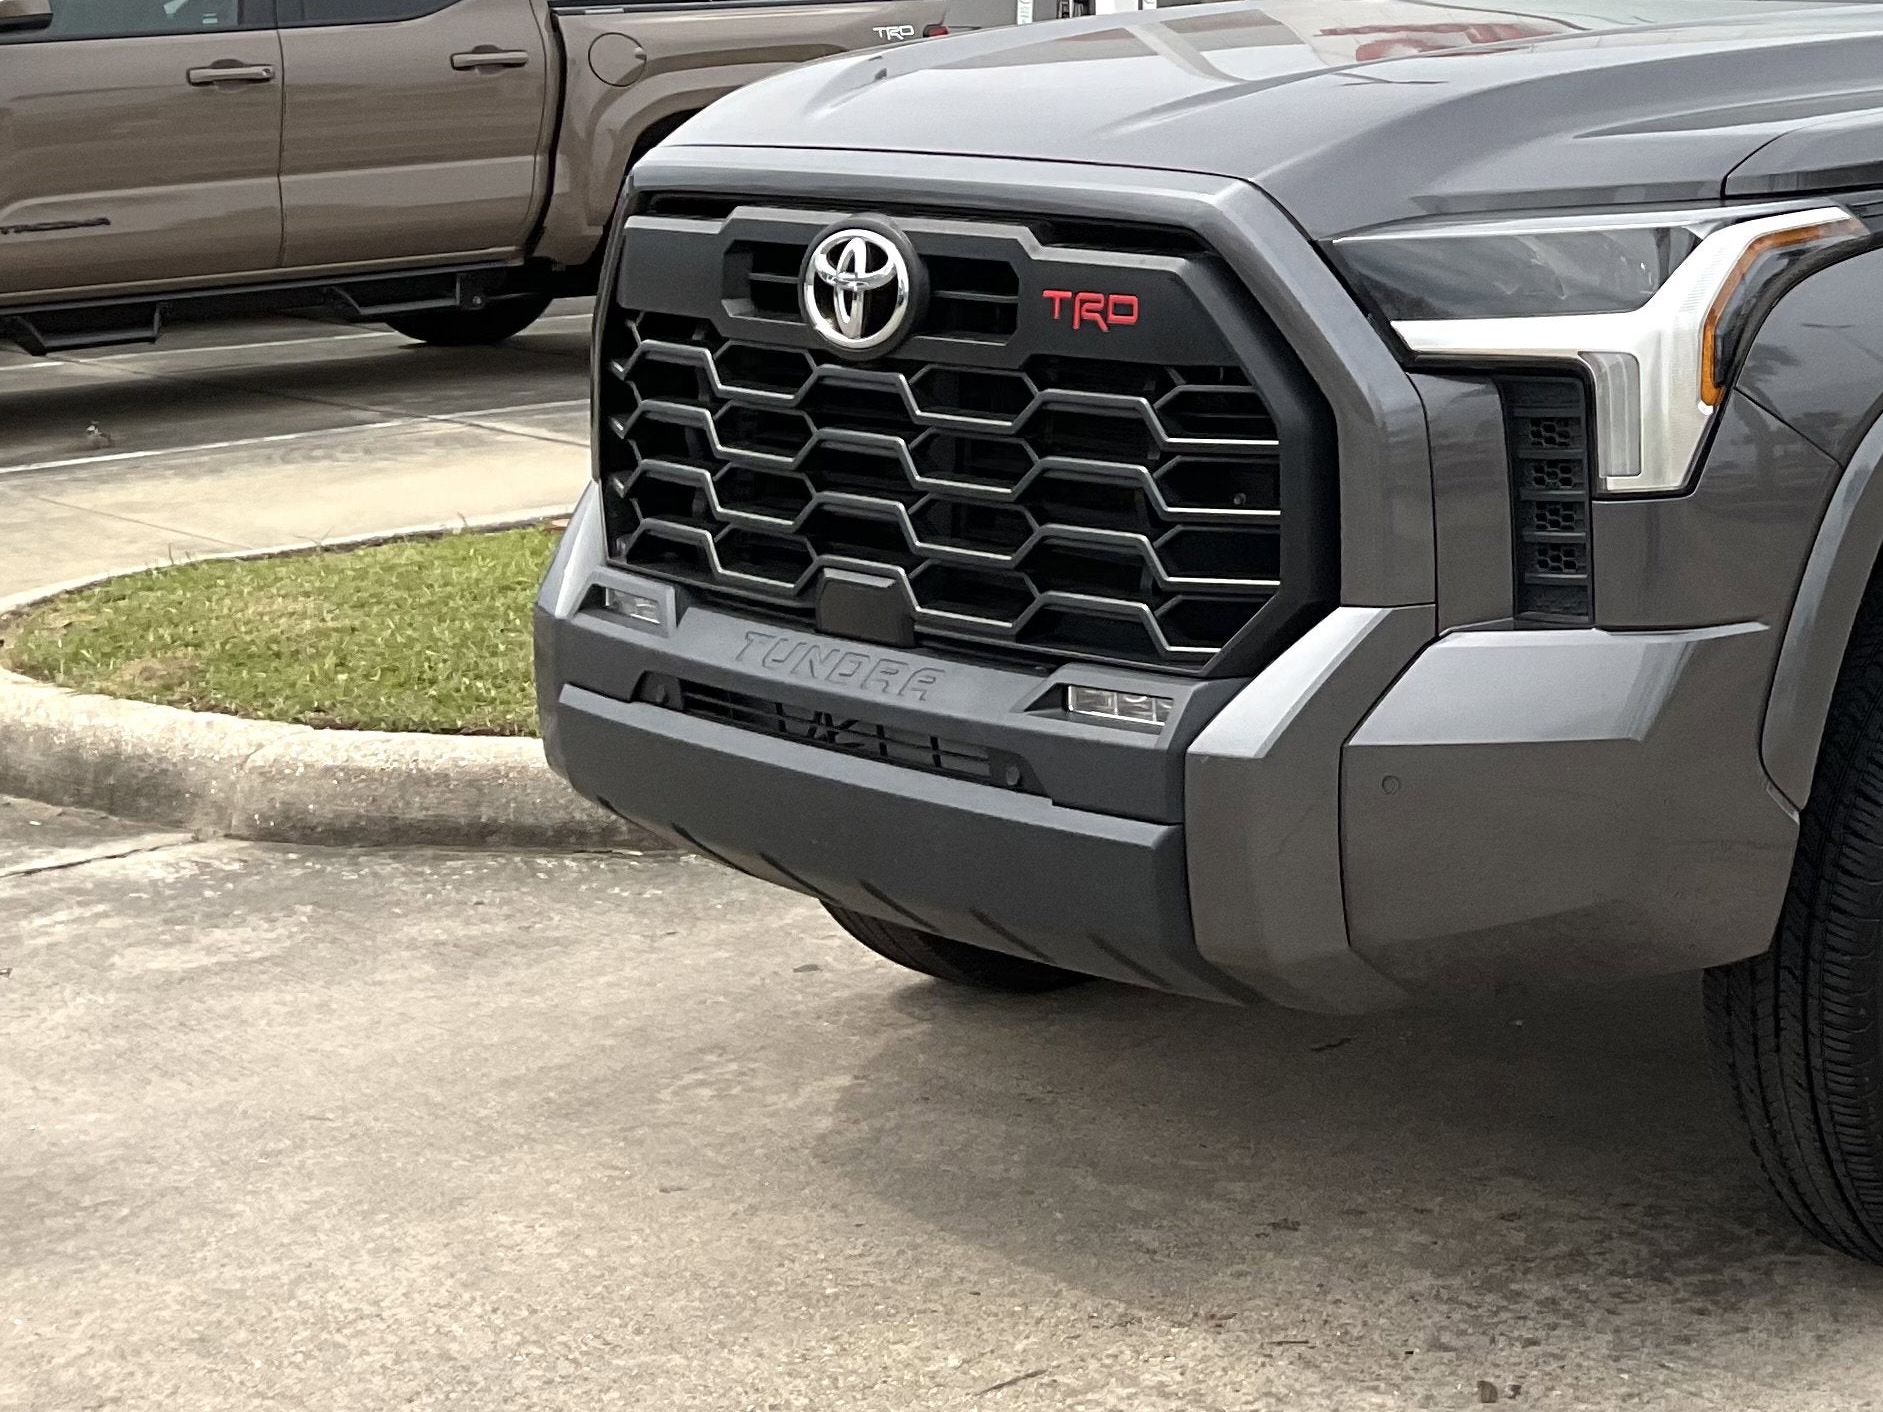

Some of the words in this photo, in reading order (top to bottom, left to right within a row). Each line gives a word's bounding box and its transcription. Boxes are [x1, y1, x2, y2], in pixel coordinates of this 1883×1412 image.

[873, 25, 915, 41] TRD
[1042, 289, 1140, 333] TRD
[735, 630, 947, 701] TUNDRA
